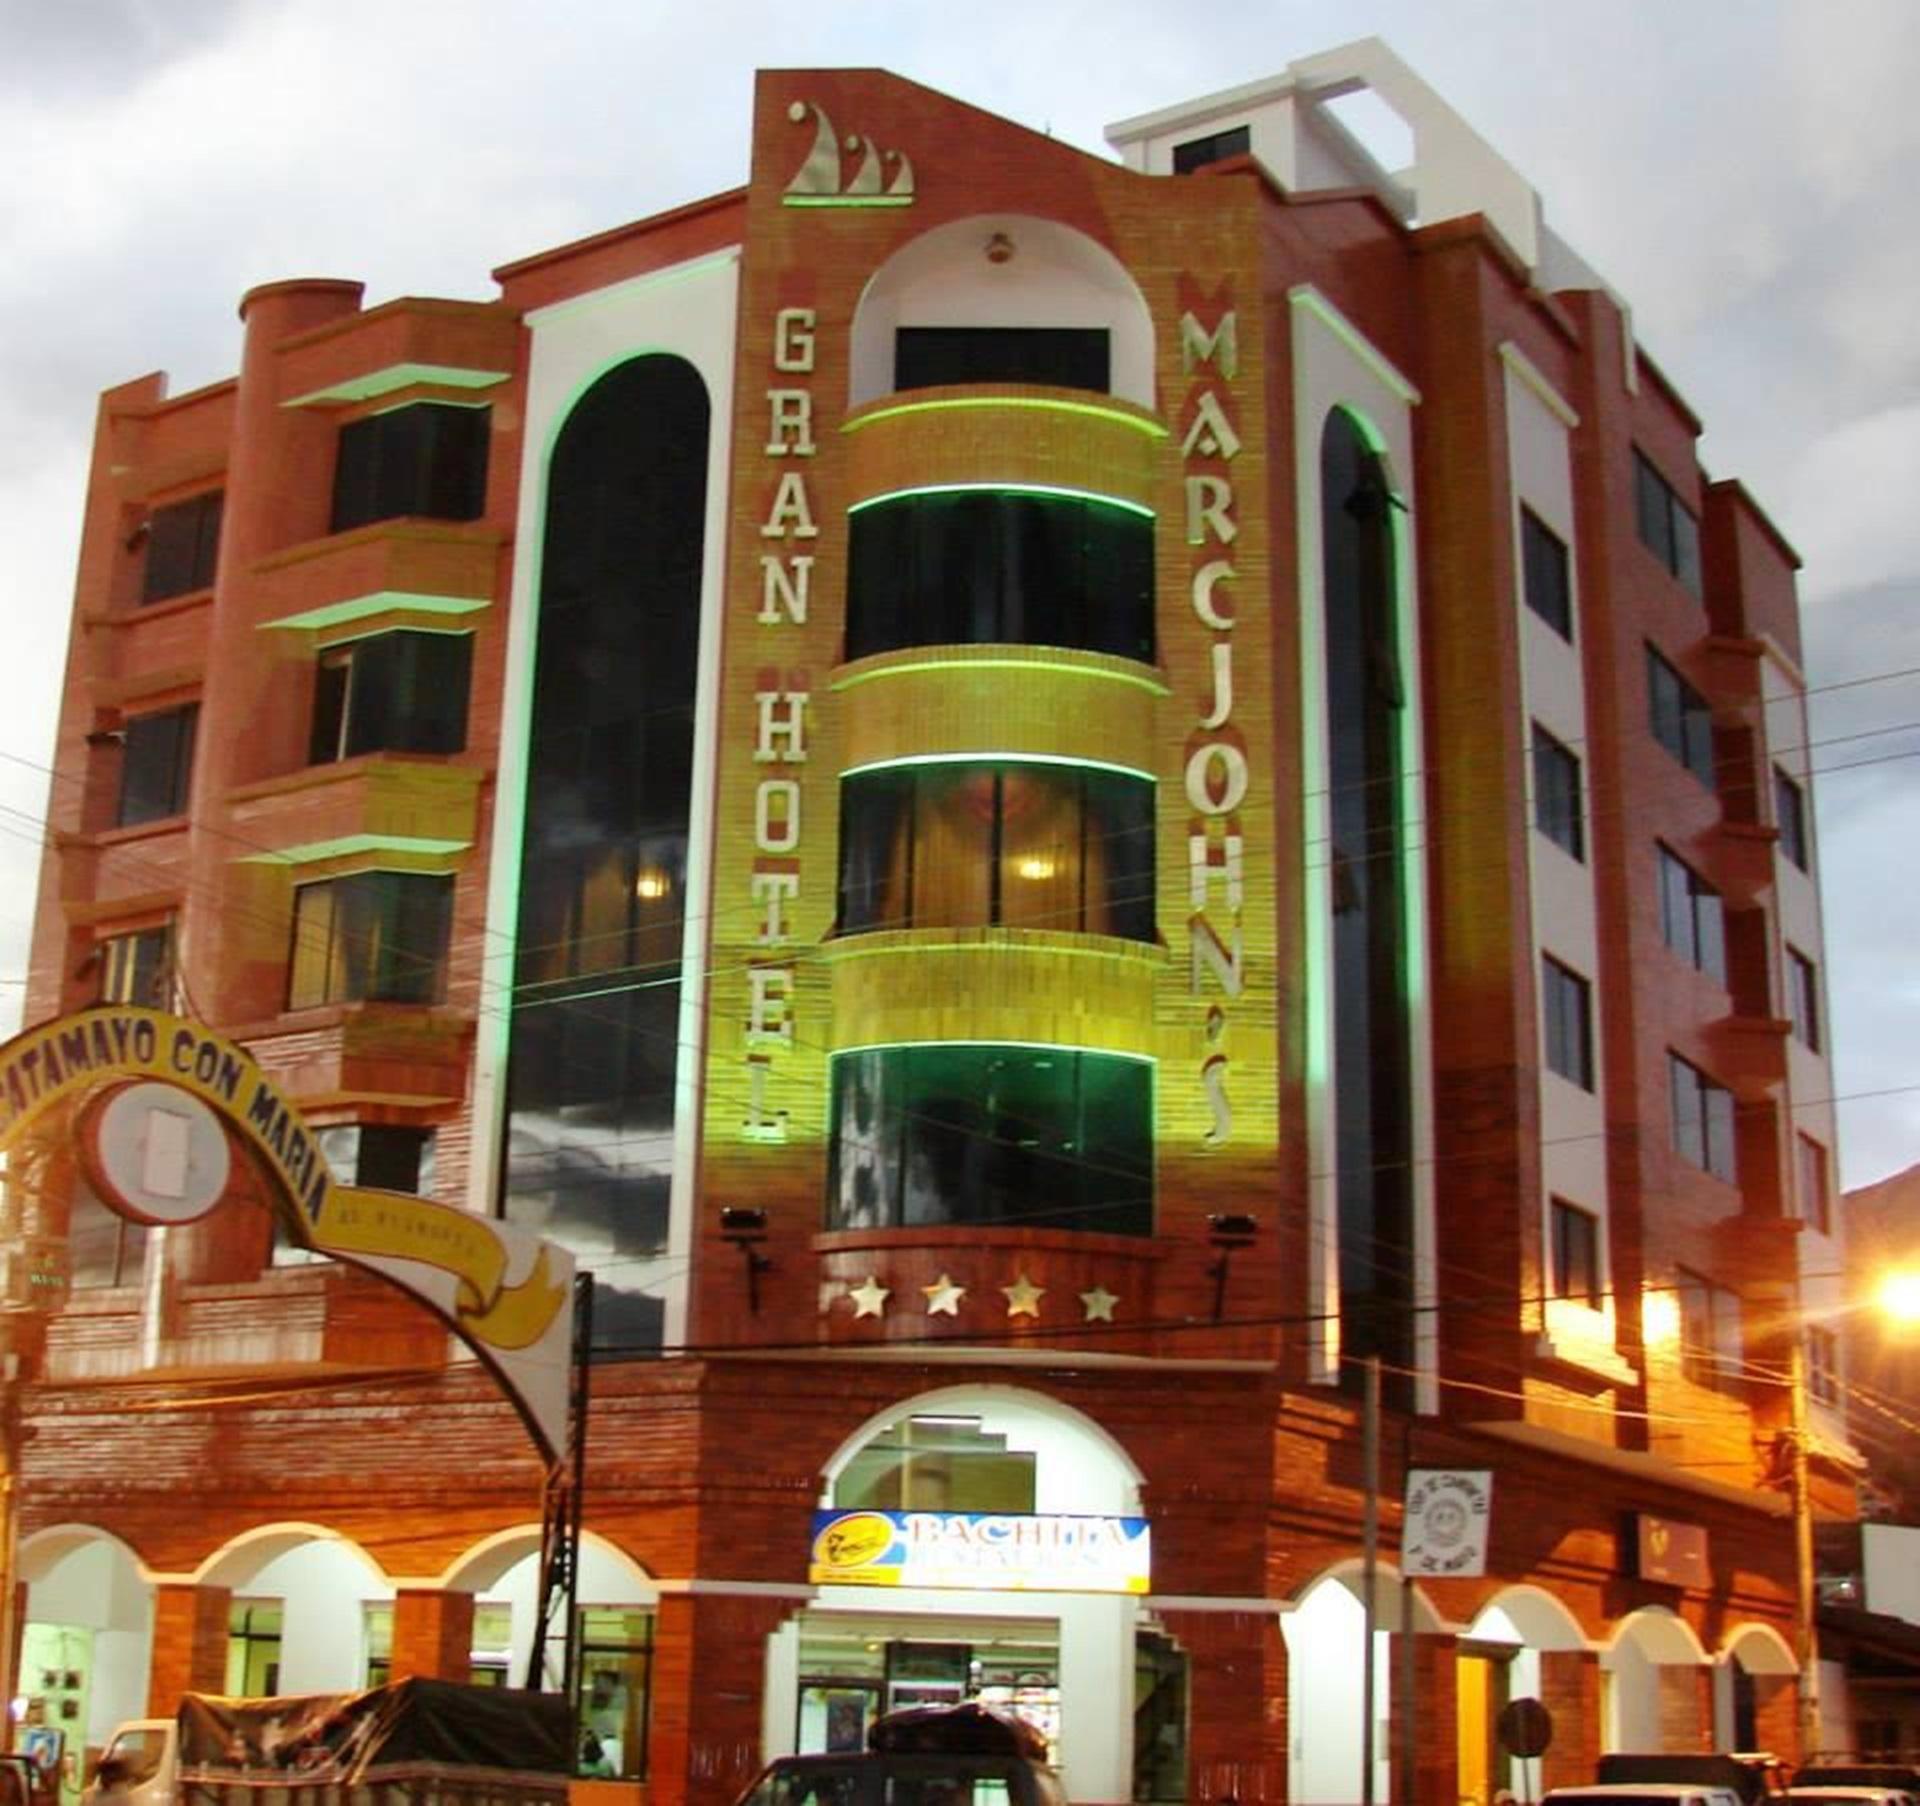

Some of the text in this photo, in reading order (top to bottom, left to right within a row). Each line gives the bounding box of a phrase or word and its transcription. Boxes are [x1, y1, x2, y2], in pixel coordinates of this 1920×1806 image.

[741, 308, 819, 1143] GRAN HOTEL
[0, 1017, 328, 1226] ATAMAYO CON MARIA
